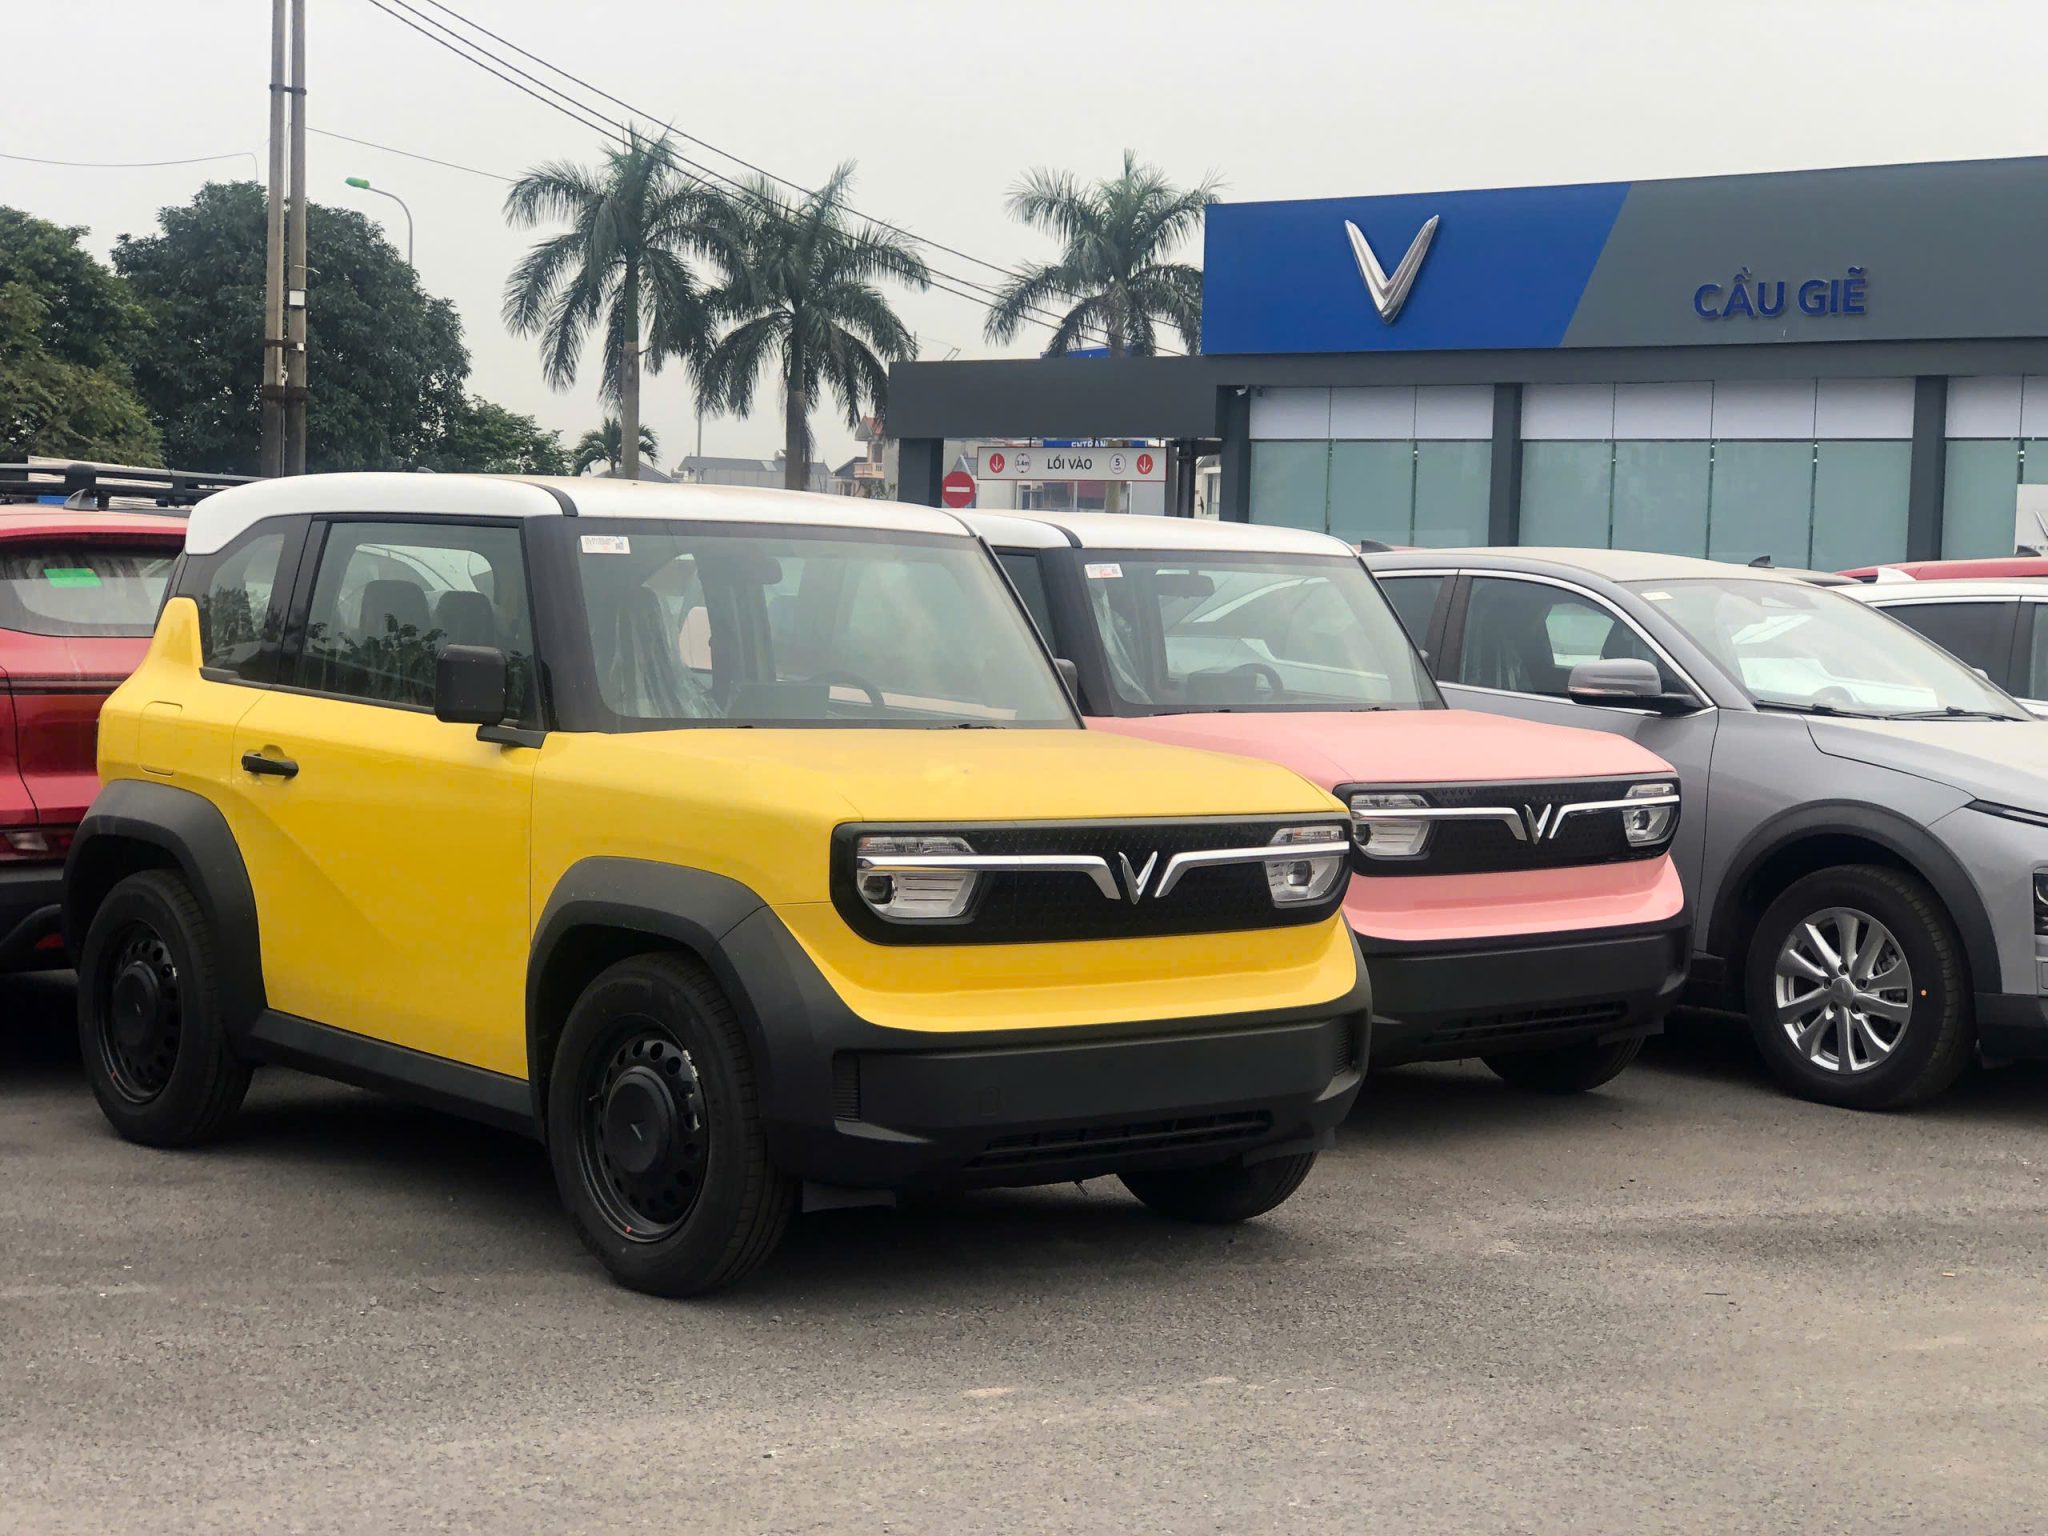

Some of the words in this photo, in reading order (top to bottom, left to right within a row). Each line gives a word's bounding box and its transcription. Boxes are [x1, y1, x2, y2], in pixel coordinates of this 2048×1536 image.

[1694, 265, 1786, 319] CẦU
[1798, 264, 1867, 315] GIẼ
[1047, 454, 1065, 470] LỐI
[1068, 455, 1093, 470] VÀO
[1115, 458, 1121, 466] 5
